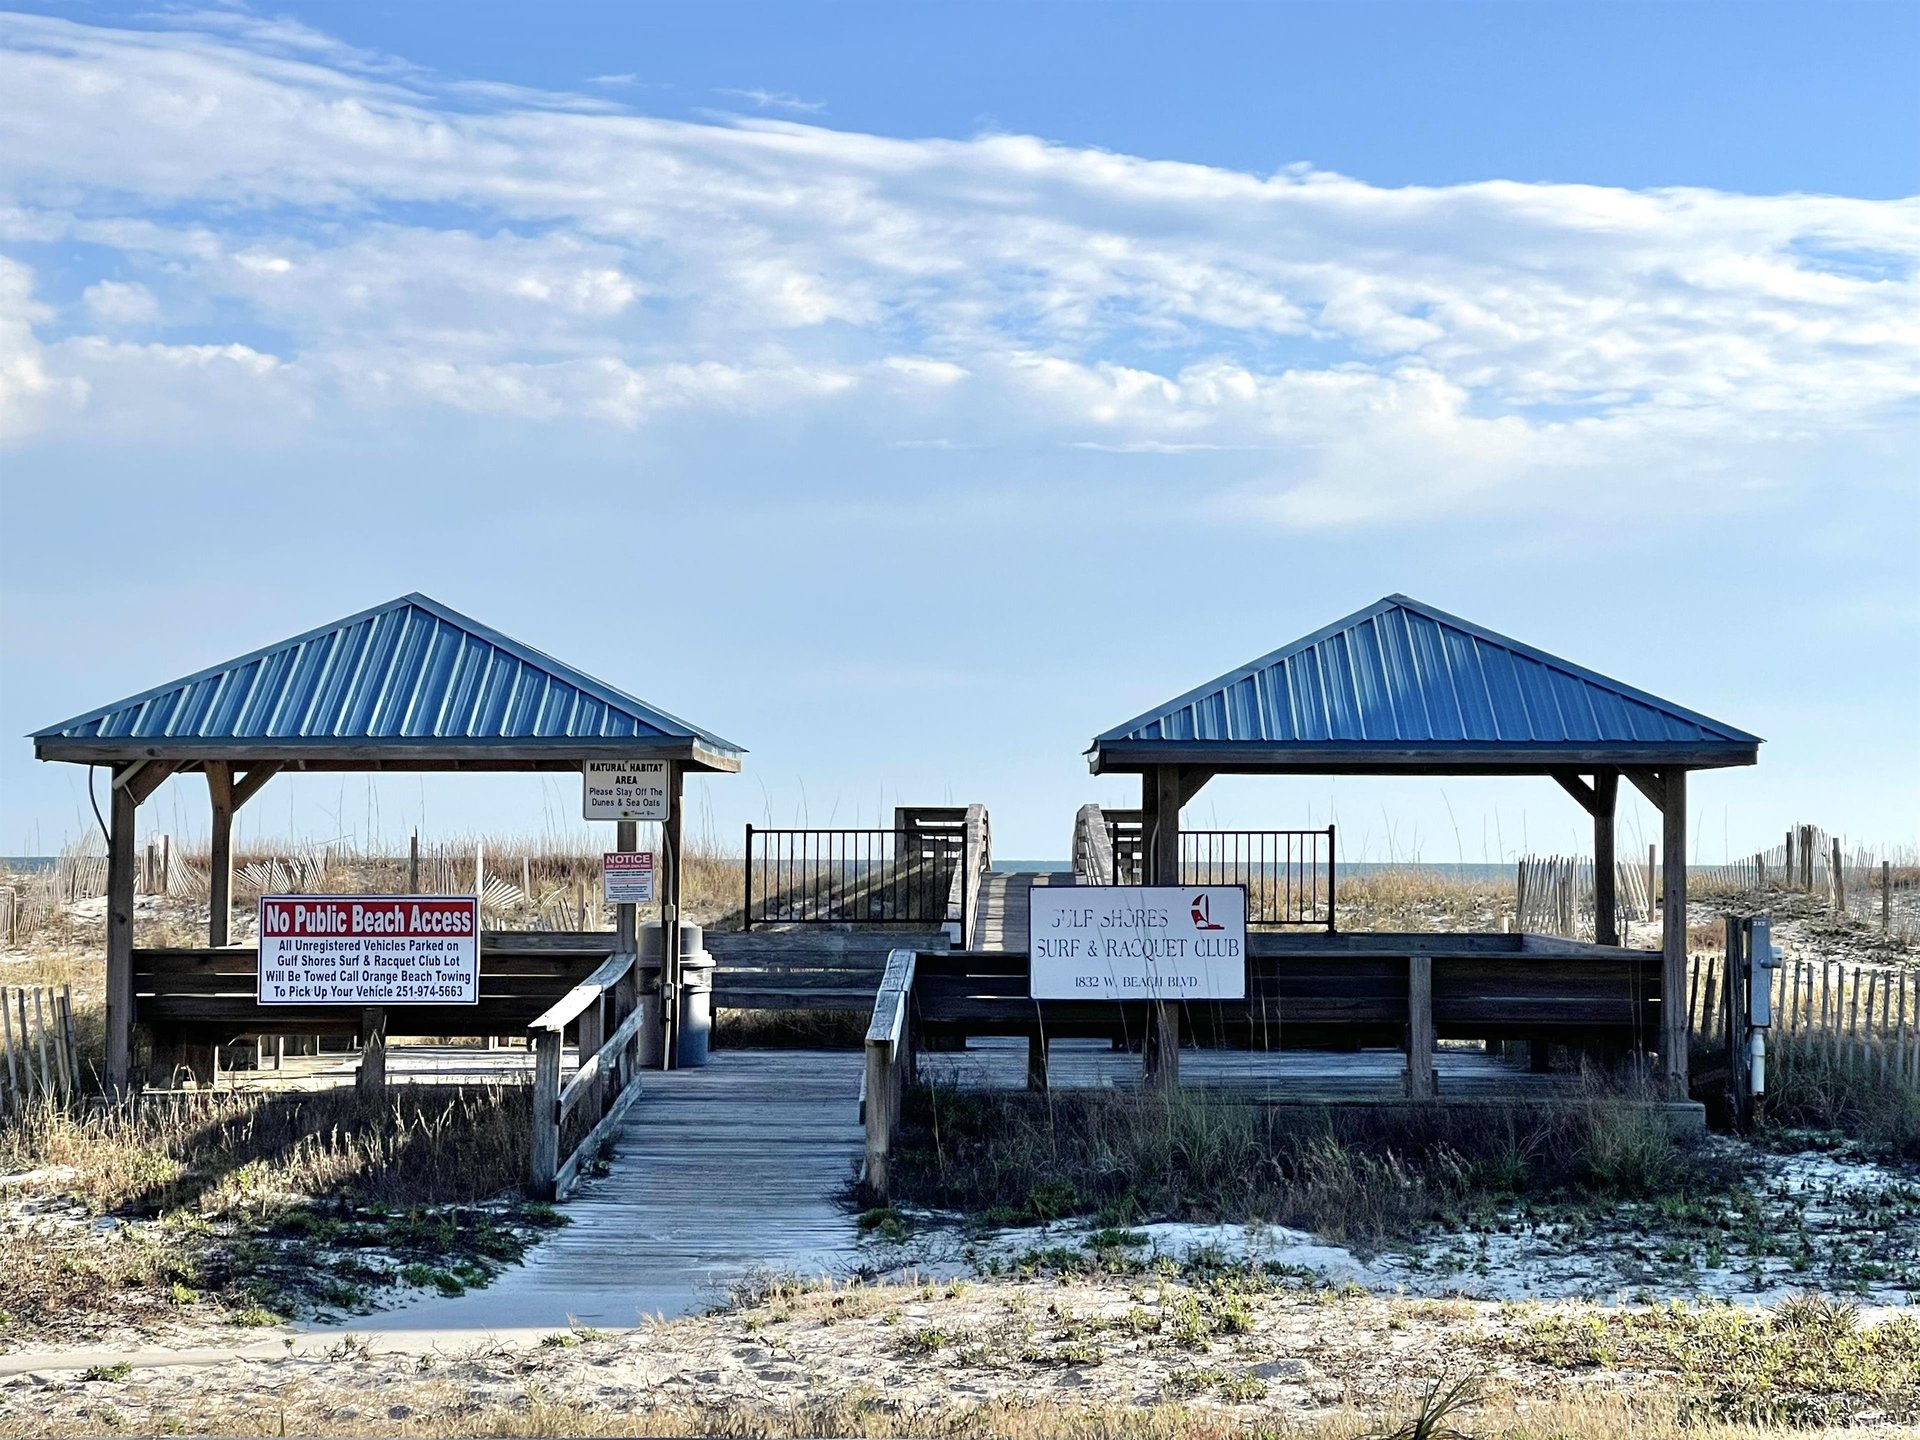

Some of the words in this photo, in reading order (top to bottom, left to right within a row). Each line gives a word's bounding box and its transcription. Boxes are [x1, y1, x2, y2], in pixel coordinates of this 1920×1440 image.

[590, 763, 626, 772] NATURAL
[630, 764, 663, 772] HABITAT
[615, 776, 638, 784] AREA
[589, 788, 613, 796] Please
[616, 788, 632, 797] Stay
[636, 788, 647, 796] Off
[650, 788, 663, 796] The
[592, 798, 614, 806] Dunes
[618, 798, 622, 806] &
[626, 798, 640, 806] Sea
[643, 798, 660, 806] Oats
[606, 855, 650, 864] NOTICE
[266, 904, 290, 932] No
[294, 904, 347, 932] Public
[352, 904, 404, 932] Beach
[409, 904, 471, 932] Access
[1100, 909, 1168, 928] SHORES
[279, 940, 292, 951] All
[295, 940, 360, 953] Unregistered
[364, 940, 405, 951] Vehicles
[409, 940, 443, 951] Parked
[447, 942, 458, 951] on
[1038, 939, 1080, 957] SURF
[1088, 940, 1098, 957] &
[1106, 939, 1187, 961] RACQUET
[1194, 939, 1239, 957] CLUB
[278, 955, 298, 966] Gulf
[301, 955, 336, 966] Shores
[339, 955, 360, 966] Surf
[364, 955, 370, 966] &
[374, 955, 415, 969] Racquet
[419, 955, 440, 966] Club
[444, 955, 460, 966] Lot
[266, 970, 284, 981] Will
[288, 970, 300, 981] Be
[304, 970, 336, 981] Towed
[340, 970, 358, 981] Call
[362, 970, 398, 984] Orange
[402, 970, 432, 981] Beach
[436, 970, 470, 984] Towing
[1075, 976, 1099, 987] 1832
[1123, 976, 1162, 987] BEACH
[274, 986, 286, 997] To
[289, 986, 310, 997] Pick
[314, 986, 327, 1000] Up
[331, 986, 353, 997] Your
[356, 986, 393, 997] Vehicle
[396, 986, 463, 997] 251-974-5663
